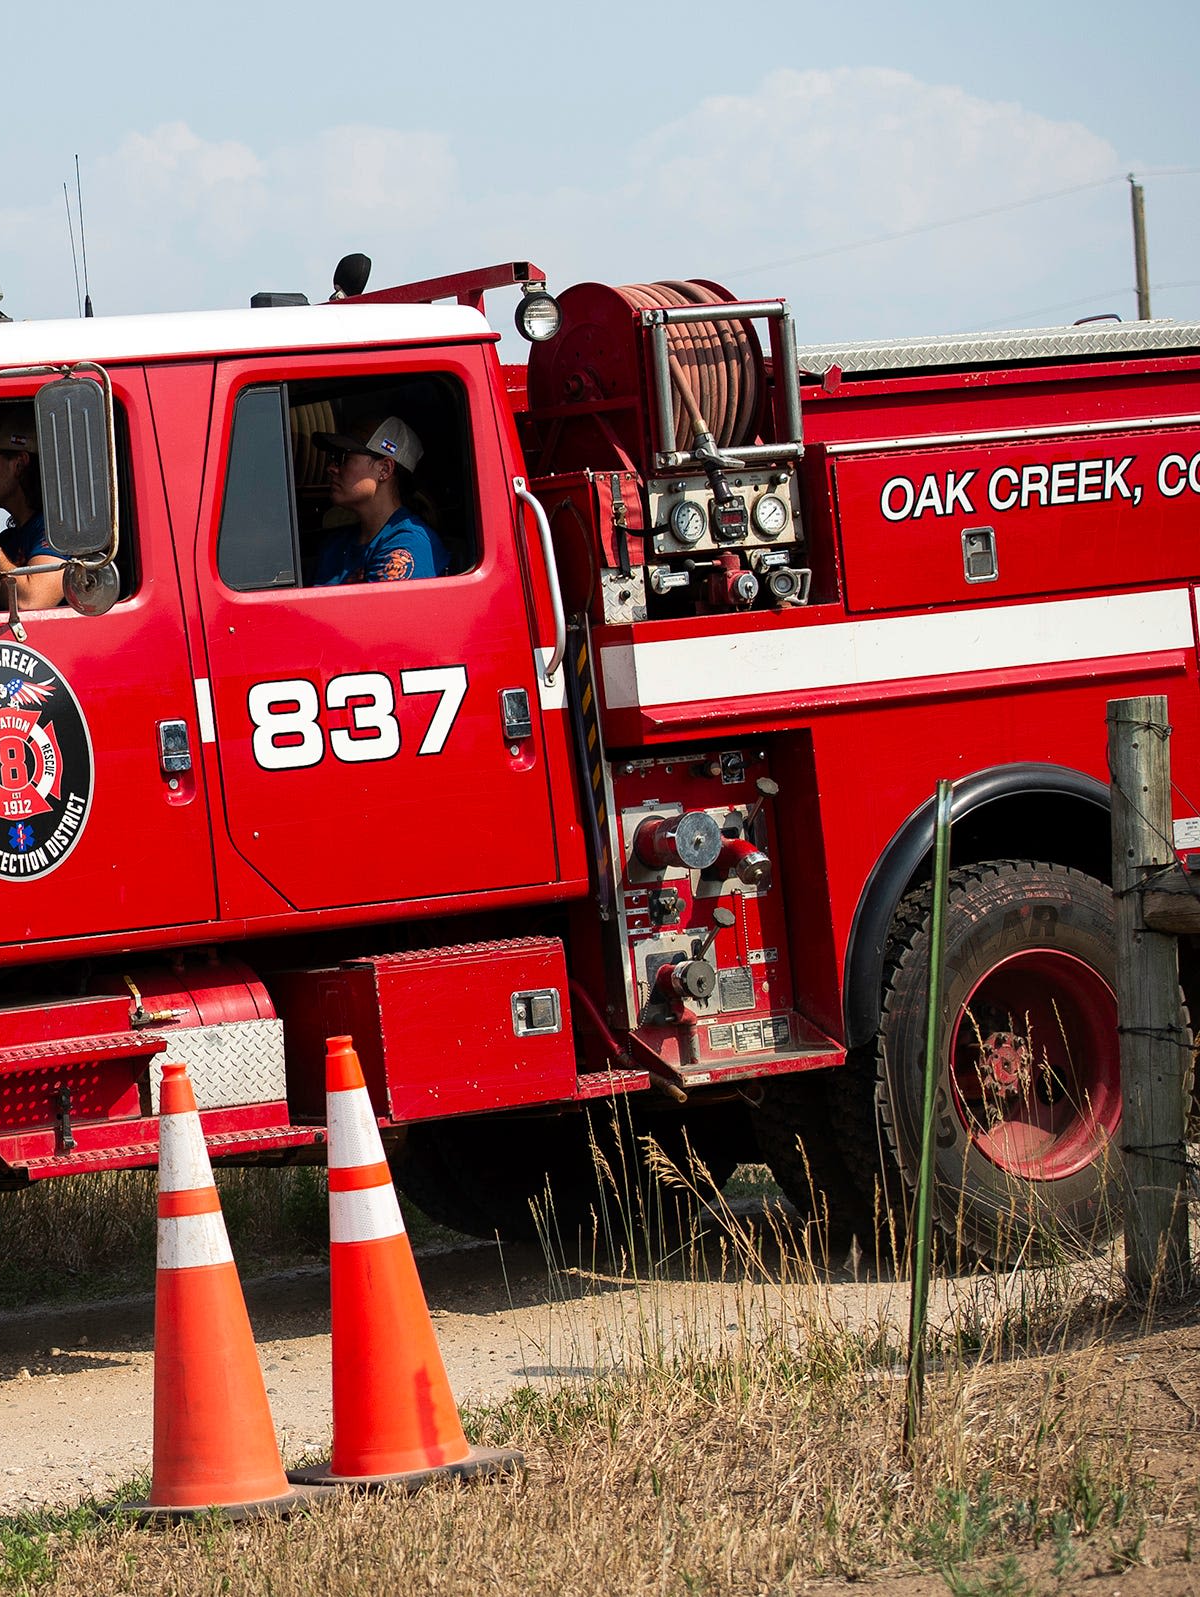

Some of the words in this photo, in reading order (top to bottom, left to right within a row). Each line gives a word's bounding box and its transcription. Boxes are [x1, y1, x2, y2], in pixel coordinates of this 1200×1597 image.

[880, 469, 978, 522] OAK
[987, 456, 1144, 511] CREEK,
[248, 664, 468, 771] 837
[41, 743, 55, 777] RESCUE
[3, 800, 33, 816] 1912
[44, 792, 86, 860] DISTRICT
